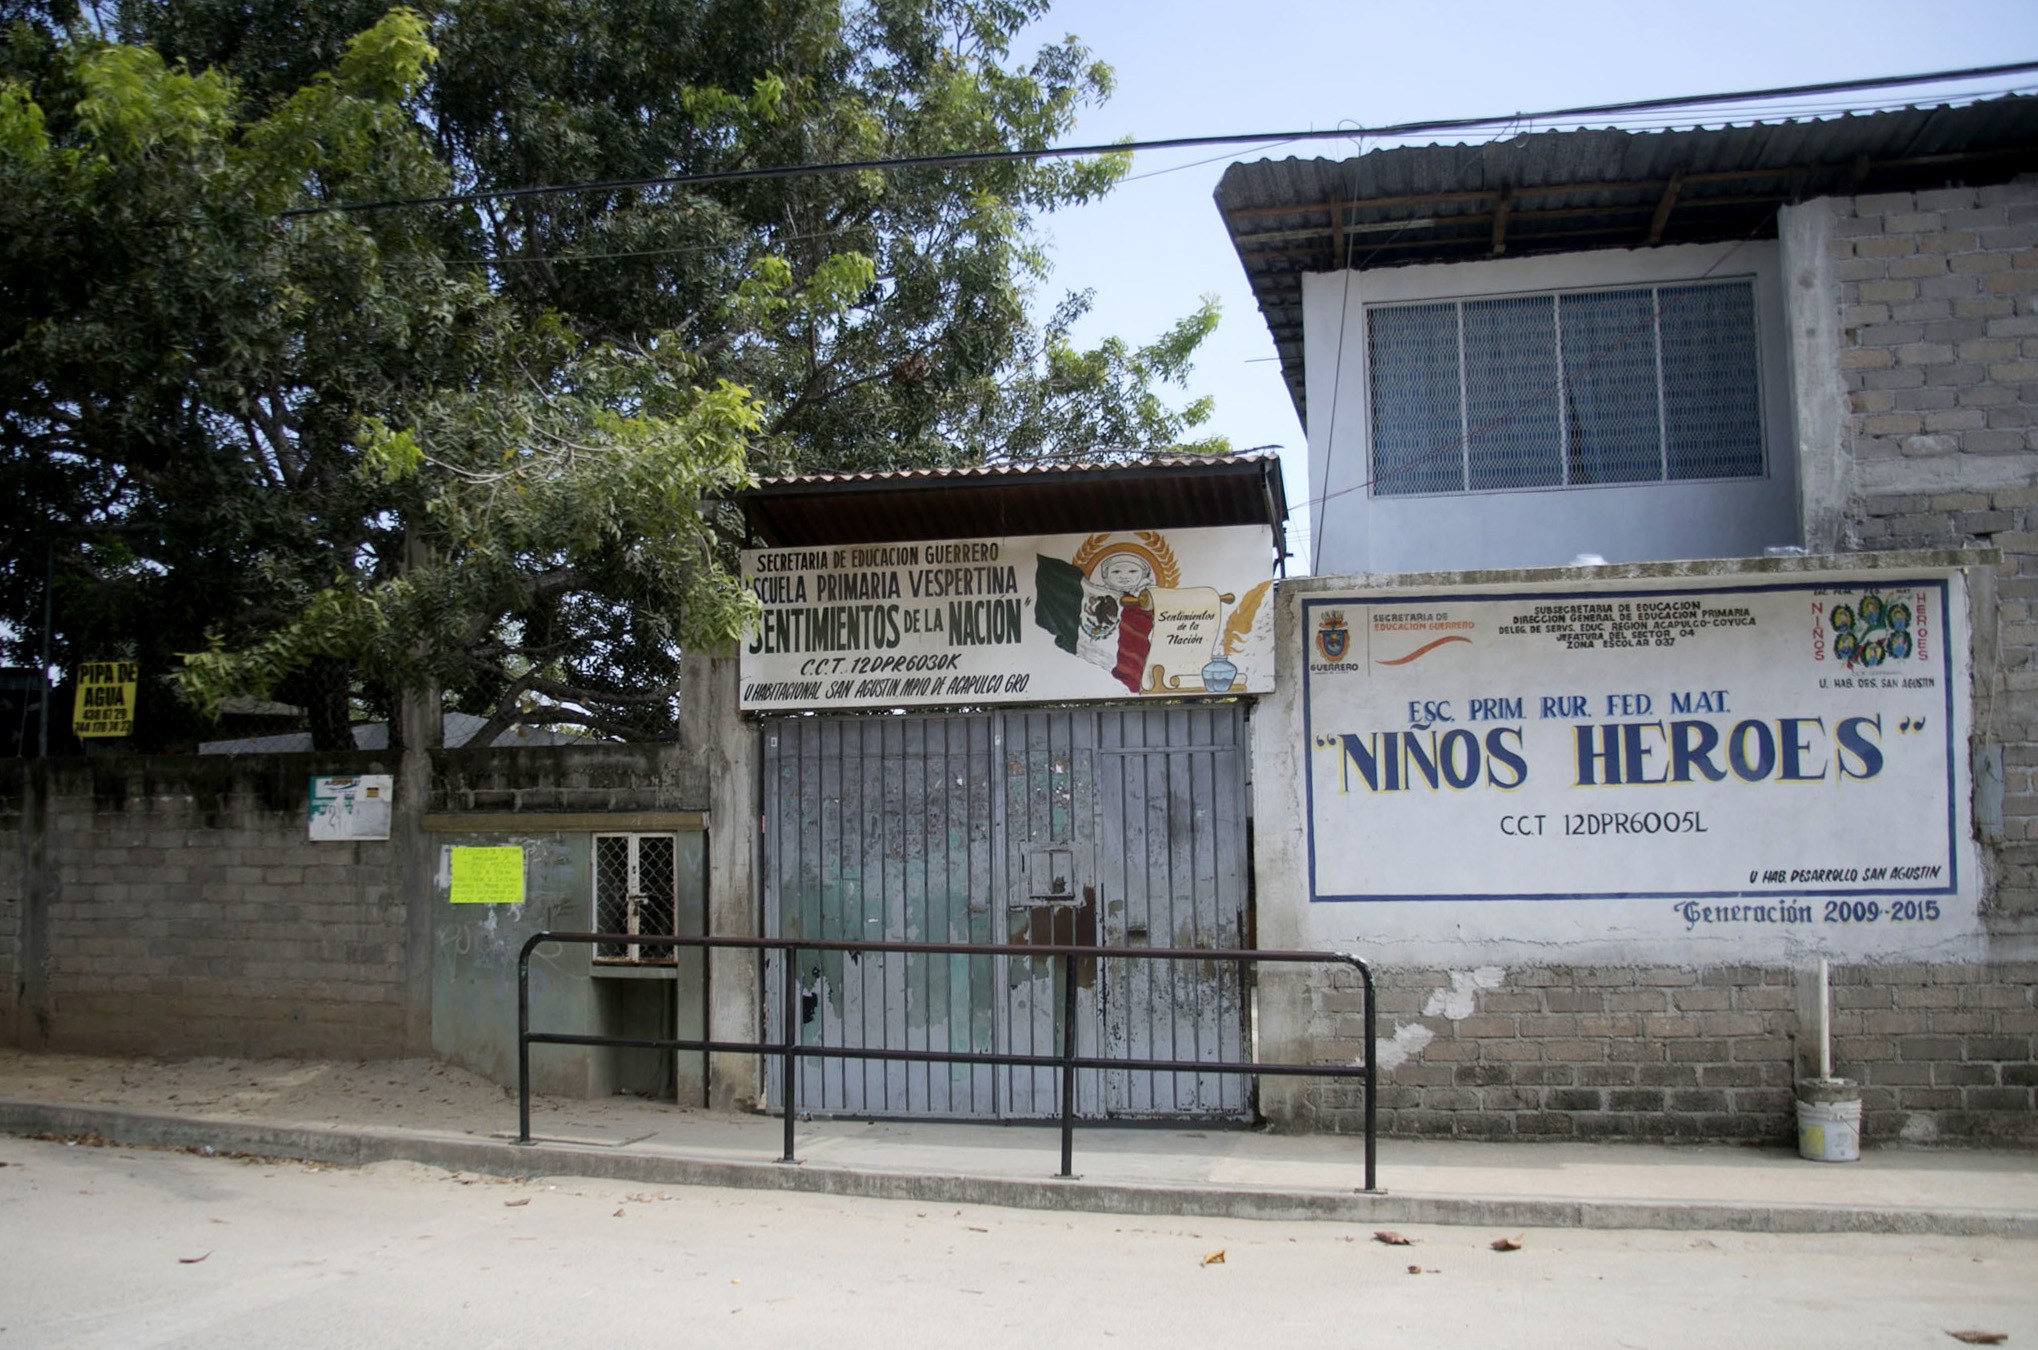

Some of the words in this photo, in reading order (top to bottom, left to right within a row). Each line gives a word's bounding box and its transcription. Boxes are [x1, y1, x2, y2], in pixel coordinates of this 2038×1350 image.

[756, 550, 828, 573] SECRETARIA
[833, 550, 847, 569] DE
[851, 546, 919, 568] EDUCACION
[925, 542, 999, 565] GUERRERO
[817, 570, 901, 602] PRIMARIA
[908, 565, 1018, 598] VESPERTINA
[1158, 609, 1215, 622] Sentimientos
[1512, 614, 1566, 625] DIRECCION
[1569, 612, 1616, 623] GENERAL
[1619, 612, 1632, 622] DE
[1637, 610, 1697, 621] EDUCACION
[1701, 607, 1751, 618] PRIMARIA
[1534, 604, 1613, 616] SUBSECRETARIA
[1618, 603, 1631, 613] DE
[1635, 601, 1701, 612] EDUCACION
[904, 608, 920, 634] DE
[924, 607, 944, 633] LA
[1176, 622, 1187, 631] de
[1189, 621, 1200, 631] la
[1373, 613, 1434, 623] SECRETARIA
[1436, 613, 1448, 621] DE
[1374, 622, 1427, 632] EDUCACION
[1428, 621, 1475, 631] GUERRERO
[1530, 624, 1542, 634] DE
[1611, 620, 1648, 631] REGION
[1166, 633, 1203, 645] Nación
[1556, 632, 1604, 642] JEFATURA
[1608, 631, 1628, 641] DEL
[1631, 629, 1671, 640] SECTOR
[1679, 628, 1695, 638] 04
[1566, 640, 1595, 650] ZONA
[1602, 638, 1650, 649] ESCOLAR
[1655, 637, 1676, 647] 037
[850, 653, 963, 674] 12DPR6030K
[1310, 662, 1359, 672] GUERRERO
[80, 663, 113, 685] PIPA
[117, 662, 137, 683] DE
[751, 679, 821, 702] HABITACIONAL
[825, 679, 852, 700] SAN
[930, 676, 948, 697] DE
[1881, 678, 1898, 689] SAN
[1901, 677, 1935, 689] AGUSTIN
[84, 686, 125, 707] AGUA
[1407, 700, 1455, 723] ESC.
[1539, 695, 1591, 719] RUR.
[1606, 693, 1653, 716] FED.
[1670, 689, 1731, 715] MAT.
[1565, 811, 1708, 836] 12DPR6005L
[1749, 870, 1758, 884] U
[1790, 868, 1858, 883] DESARROLLO
[1862, 867, 1887, 882] SAN
[1889, 865, 1942, 881] AGUSTIN
[1674, 899, 1812, 931] Generación
